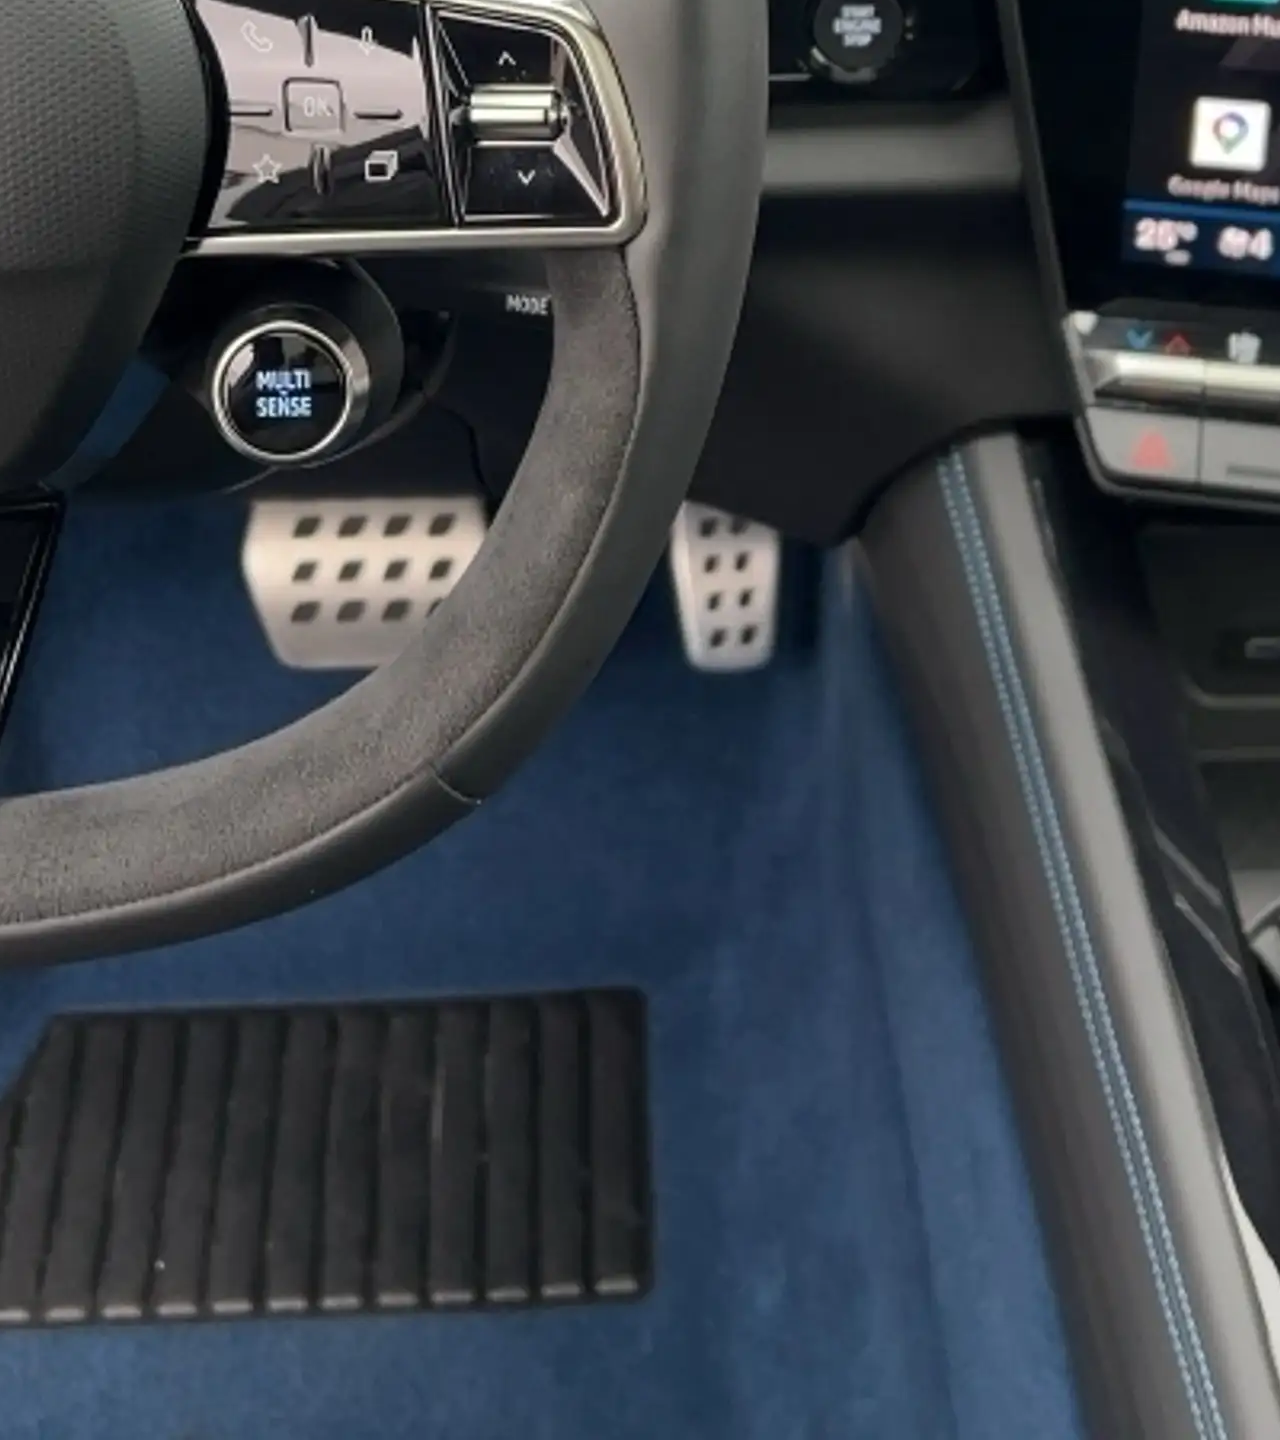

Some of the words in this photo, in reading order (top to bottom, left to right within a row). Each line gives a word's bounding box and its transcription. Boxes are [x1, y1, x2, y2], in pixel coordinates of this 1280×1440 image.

[506, 294, 549, 316] MODE
[256, 368, 312, 391] MULTI
[256, 395, 312, 418] SENSE
